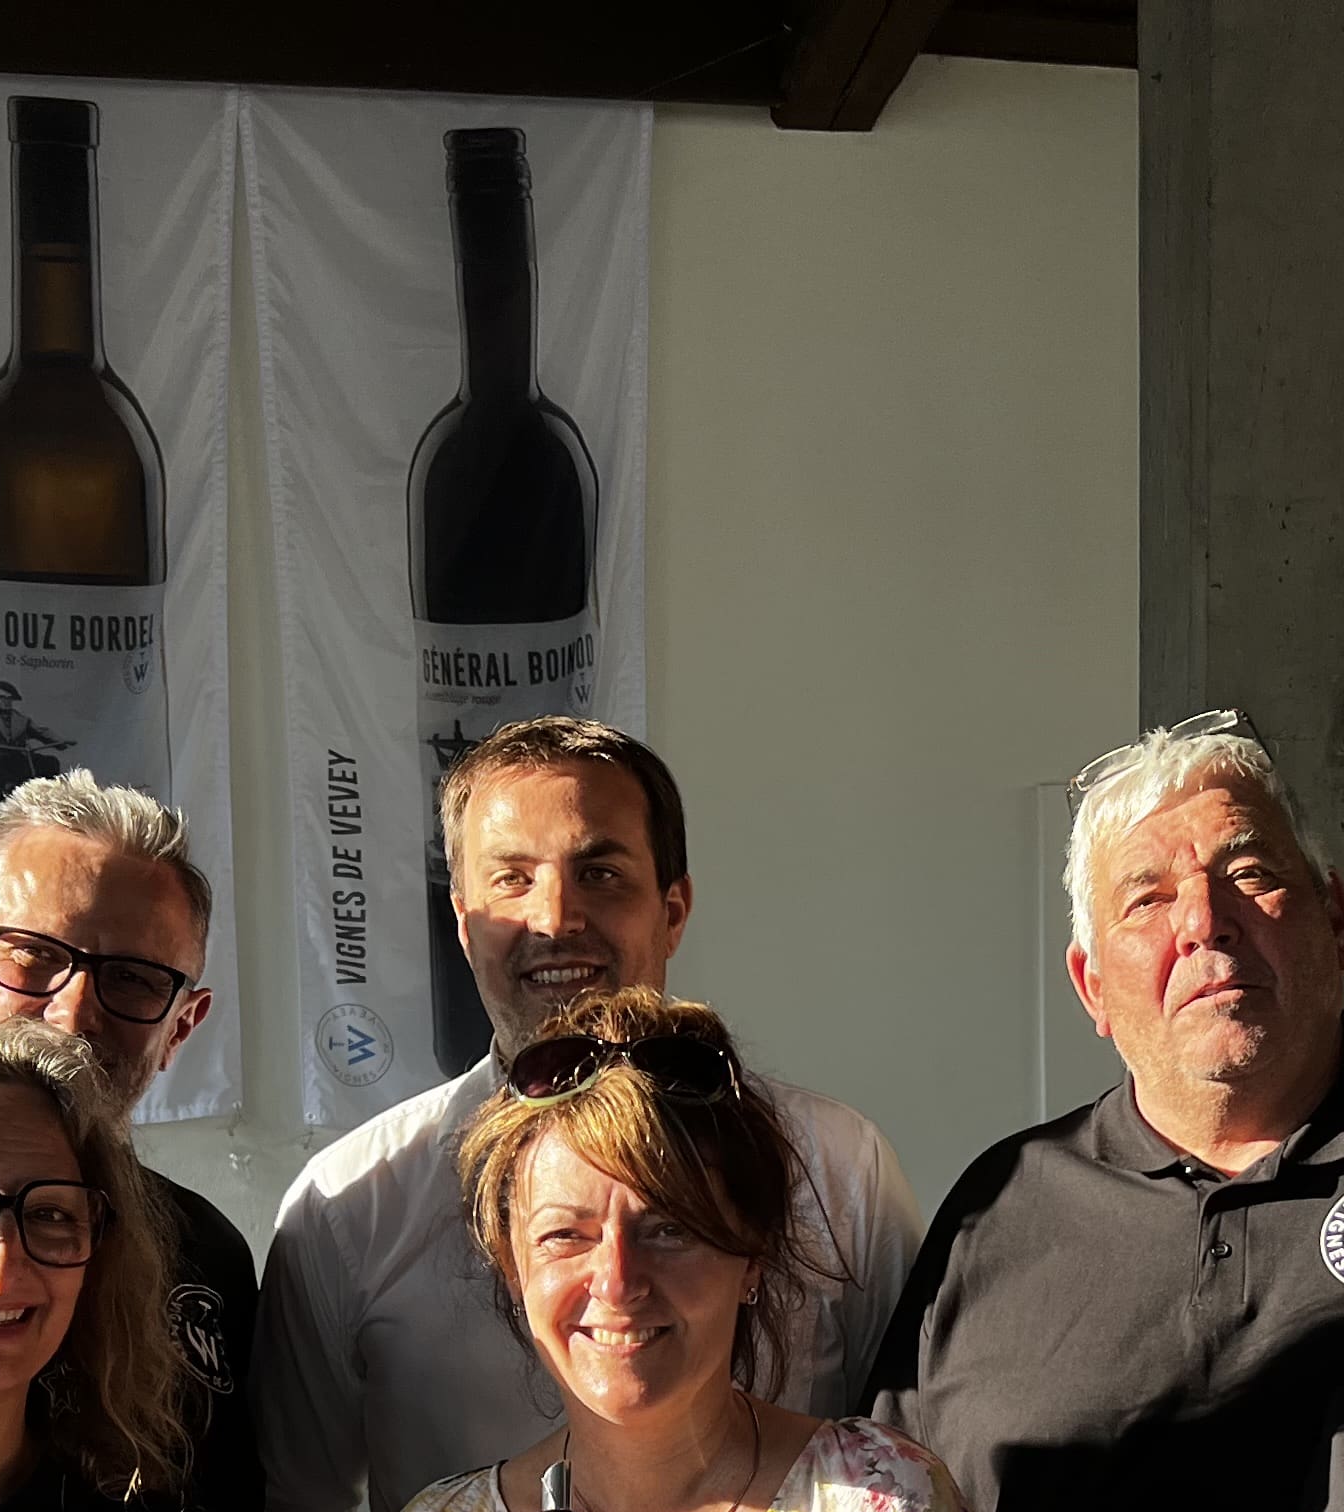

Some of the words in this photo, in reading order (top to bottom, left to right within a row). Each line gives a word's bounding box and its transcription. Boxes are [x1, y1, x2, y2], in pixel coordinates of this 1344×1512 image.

[5, 611, 57, 650] OUZ
[422, 644, 517, 687] GÉNÉRAL
[528, 633, 594, 686] BOINOD
[327, 748, 362, 836] VEVEY
[332, 845, 363, 880] DE
[333, 890, 367, 985] VIGNES
